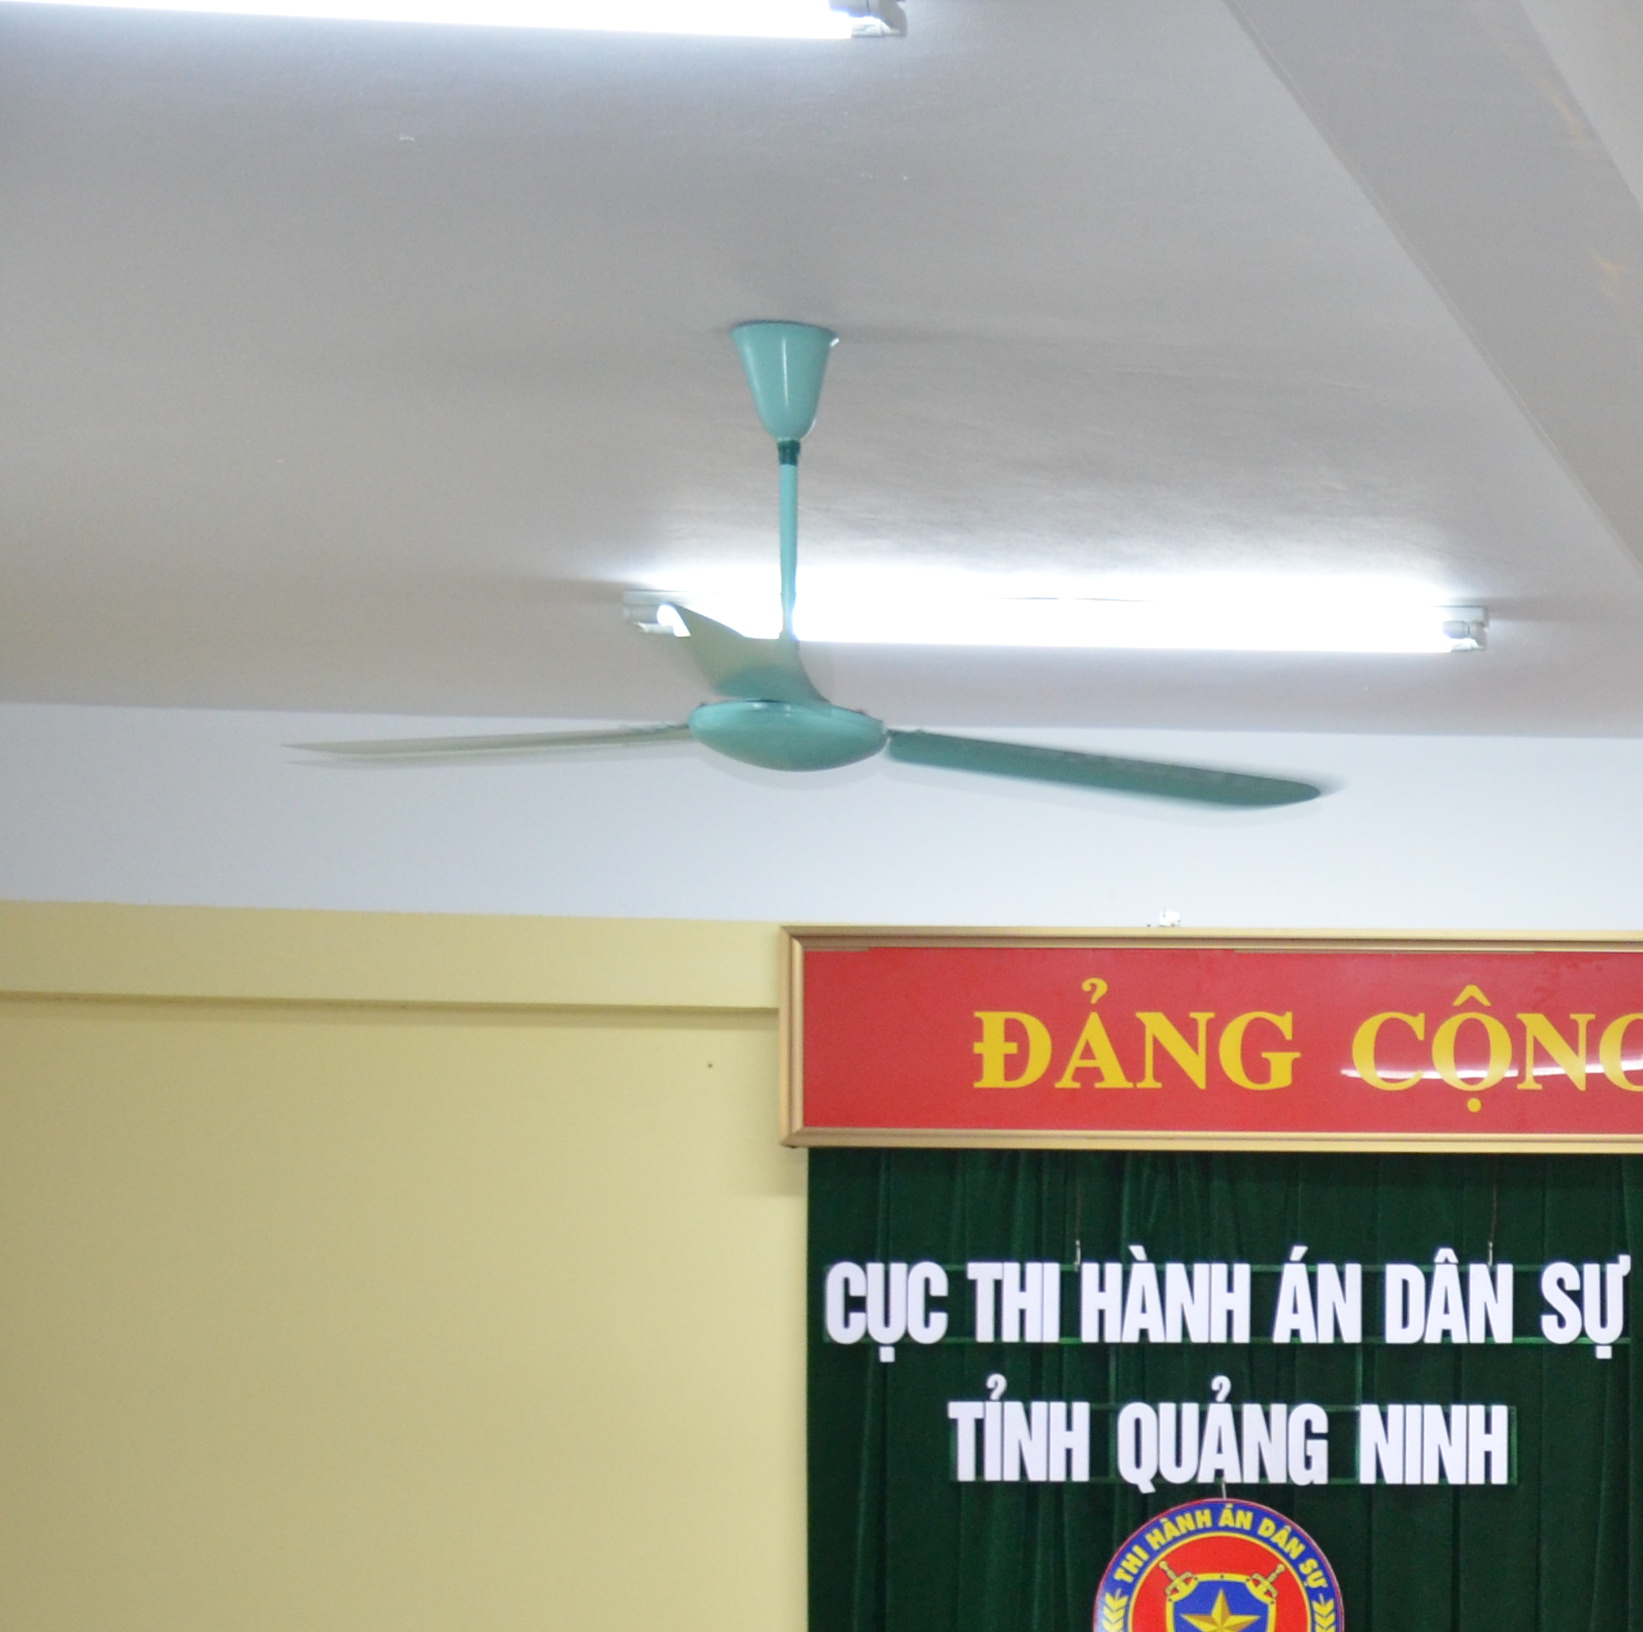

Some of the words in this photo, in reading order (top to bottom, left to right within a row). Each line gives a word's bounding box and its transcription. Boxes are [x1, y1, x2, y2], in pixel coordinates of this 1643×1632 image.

[974, 977, 1302, 1090] ĐẢNG
[825, 1261, 949, 1363] CỤC
[966, 1261, 1062, 1344] THI
[1080, 1244, 1252, 1344] HÀNH
[1272, 1245, 1363, 1344] ÁN
[1384, 1247, 1514, 1345] DÂN
[1540, 1253, 1632, 1360] SỰ
[947, 1373, 1091, 1483] TỈNH
[1116, 1374, 1329, 1494] QUẢNG
[1357, 1404, 1509, 1484] NINH
[1114, 1545, 1150, 1584] THI
[1145, 1508, 1213, 1551] HÀNH
[1218, 1503, 1254, 1530] ÁN
[1257, 1517, 1306, 1560] DÂN
[1299, 1558, 1328, 1589] SỰ
